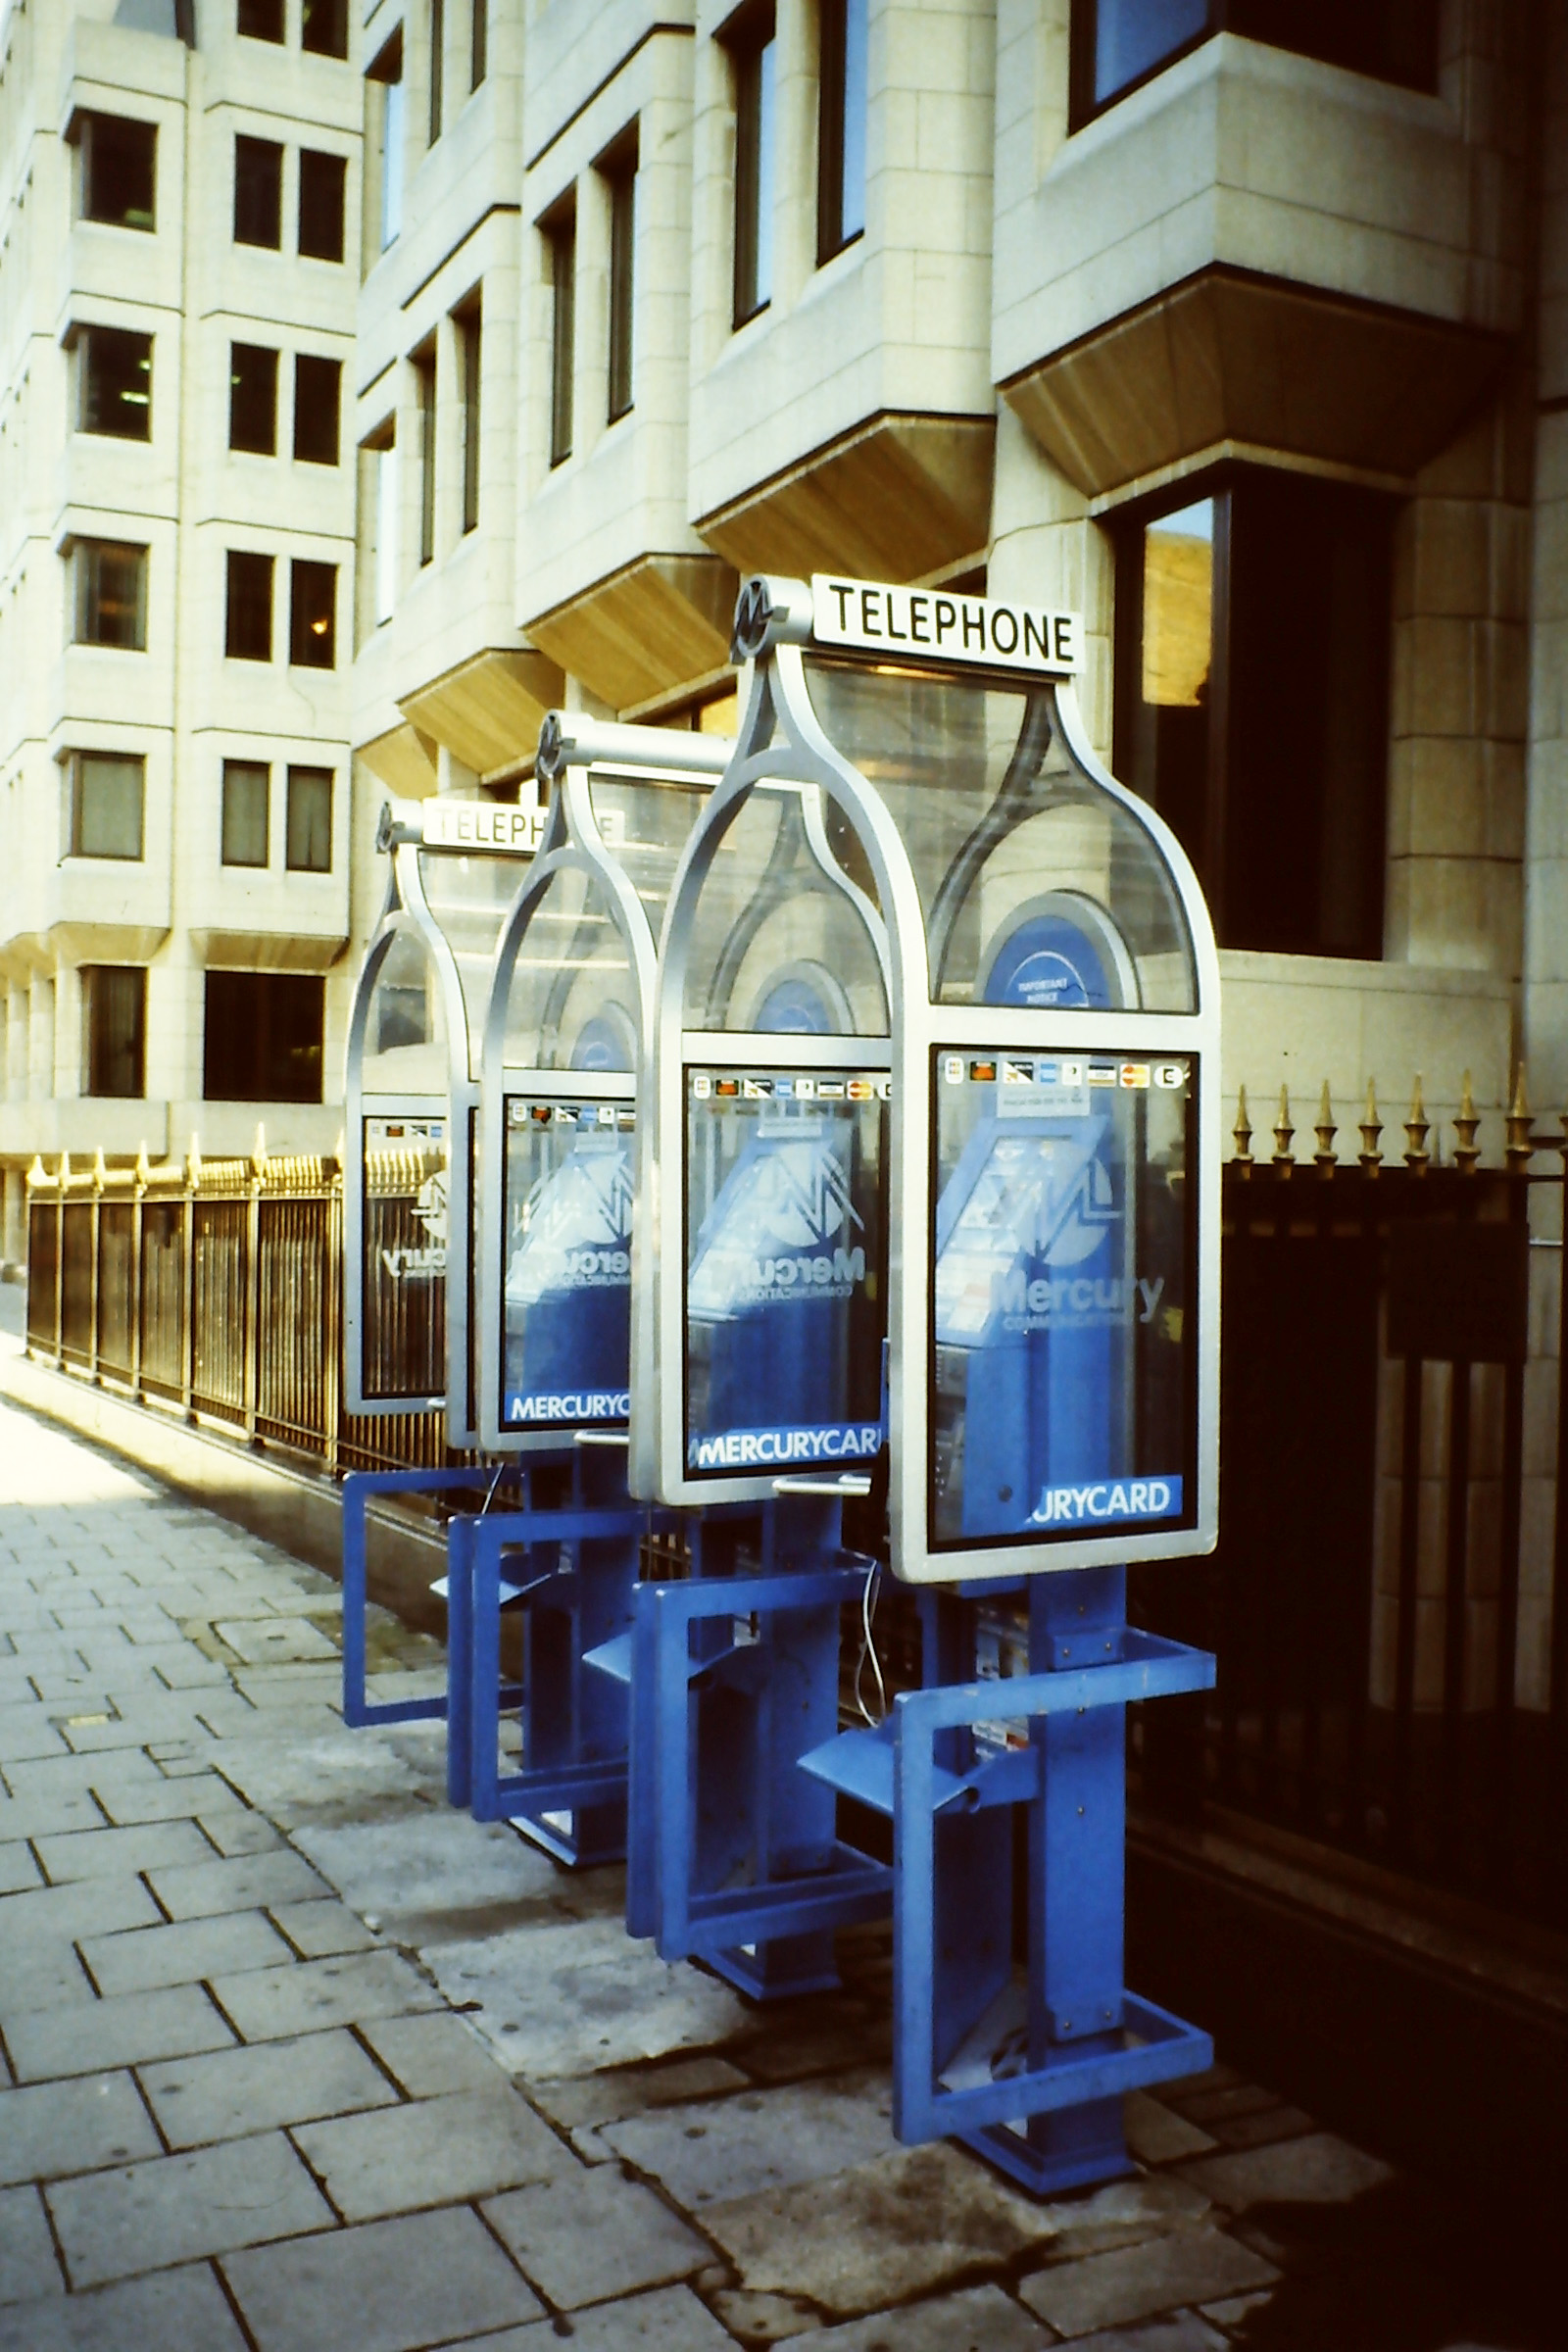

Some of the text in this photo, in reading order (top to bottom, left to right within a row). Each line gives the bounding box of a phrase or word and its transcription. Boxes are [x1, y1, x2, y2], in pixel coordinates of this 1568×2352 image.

[828, 584, 1074, 662] TELEPHONE
[435, 808, 613, 846] TELEPHE
[990, 1268, 1165, 1323] Mercury
[511, 1394, 630, 1420] MERCURYC
[699, 1428, 882, 1465] MERCURYCAR
[1031, 1481, 1171, 1523] URYCARD
